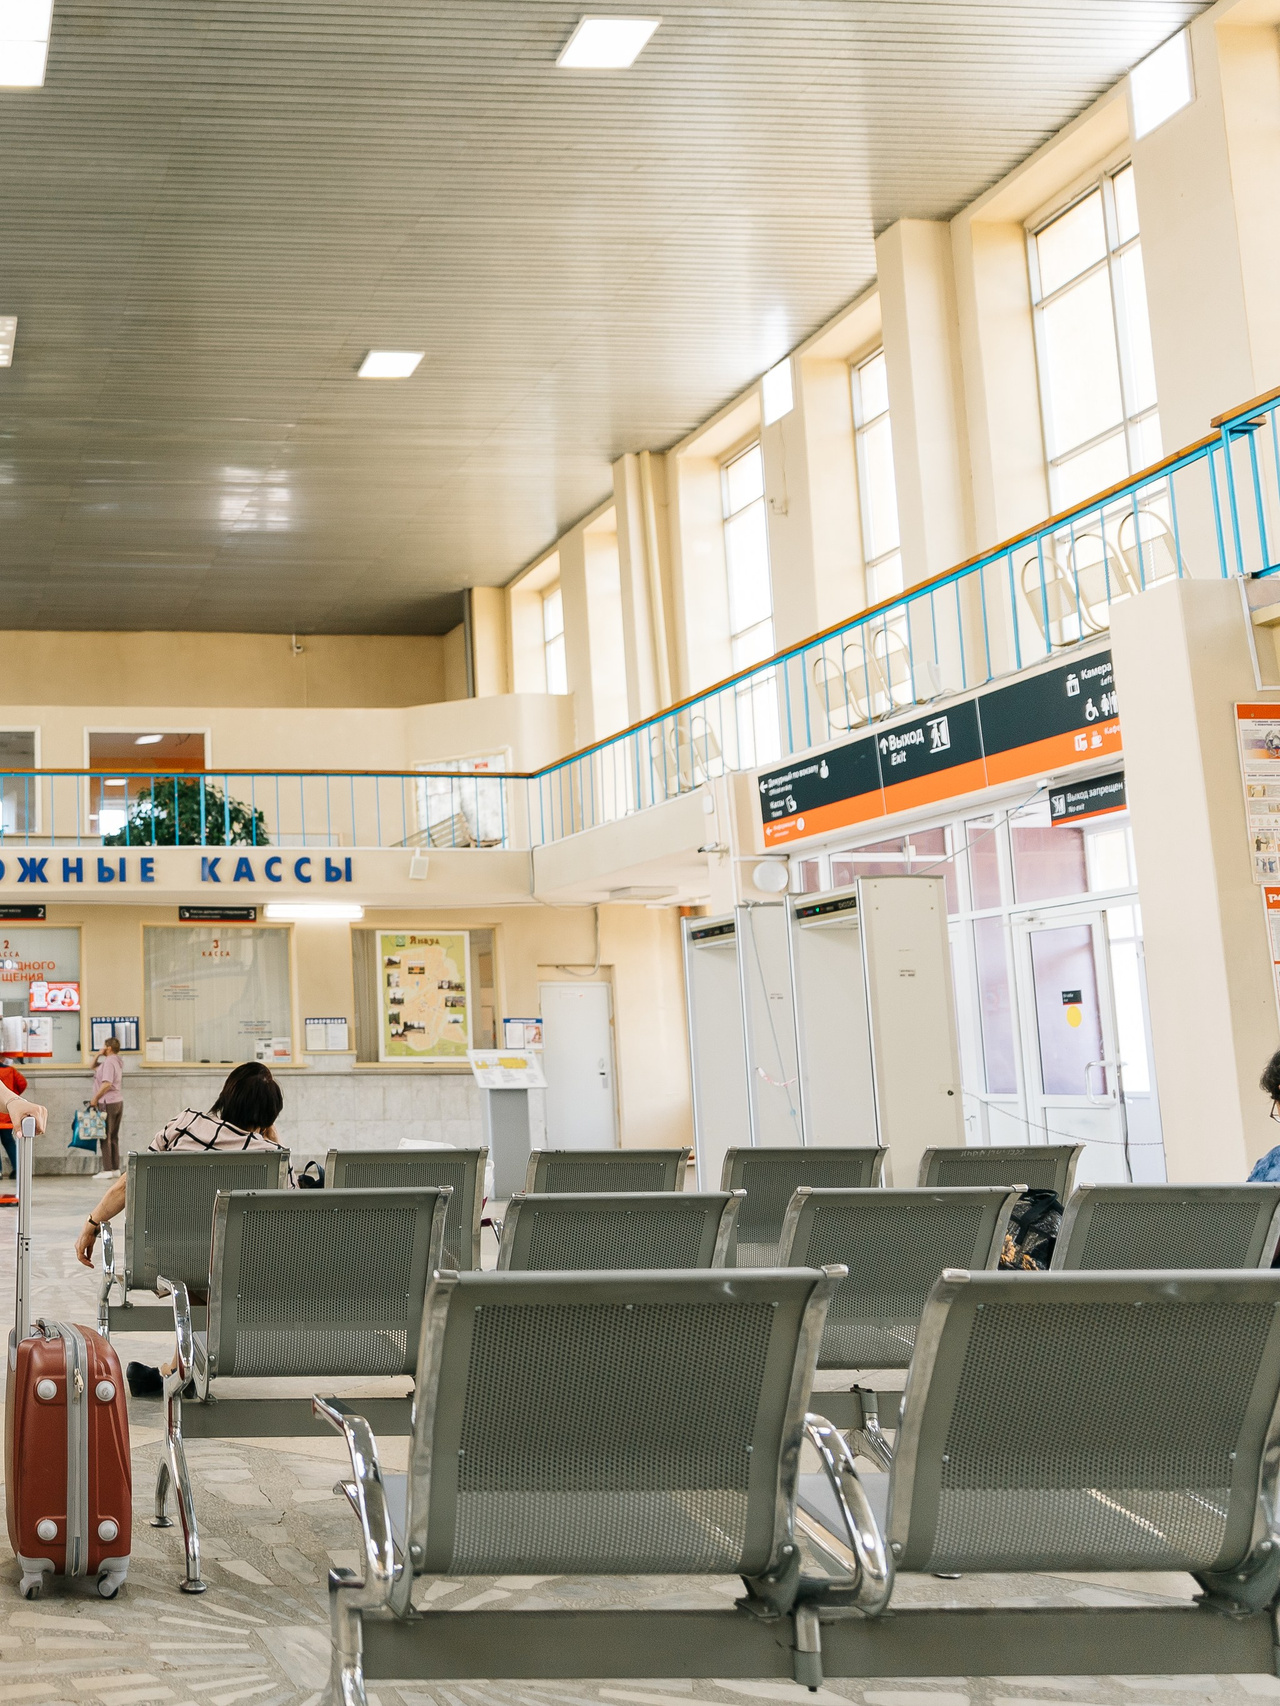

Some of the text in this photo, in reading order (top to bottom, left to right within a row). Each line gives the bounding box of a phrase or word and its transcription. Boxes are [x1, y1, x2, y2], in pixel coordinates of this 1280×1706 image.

[1081, 662, 1112, 680] Камера
[1100, 675, 1113, 687] Left
[888, 728, 925, 751] Выход
[891, 750, 907, 767] Exit
[1066, 782, 1124, 803] Выход запрещен
[1068, 802, 1085, 813] No exit
[201, 856, 353, 883] КАССЫ
[37, 907, 45, 918] 2
[248, 909, 256, 920] 3
[3, 940, 10, 949] 2
[213, 939, 220, 949] 3
[409, 935, 441, 946] Янаул
[201, 950, 231, 958] КАССА
